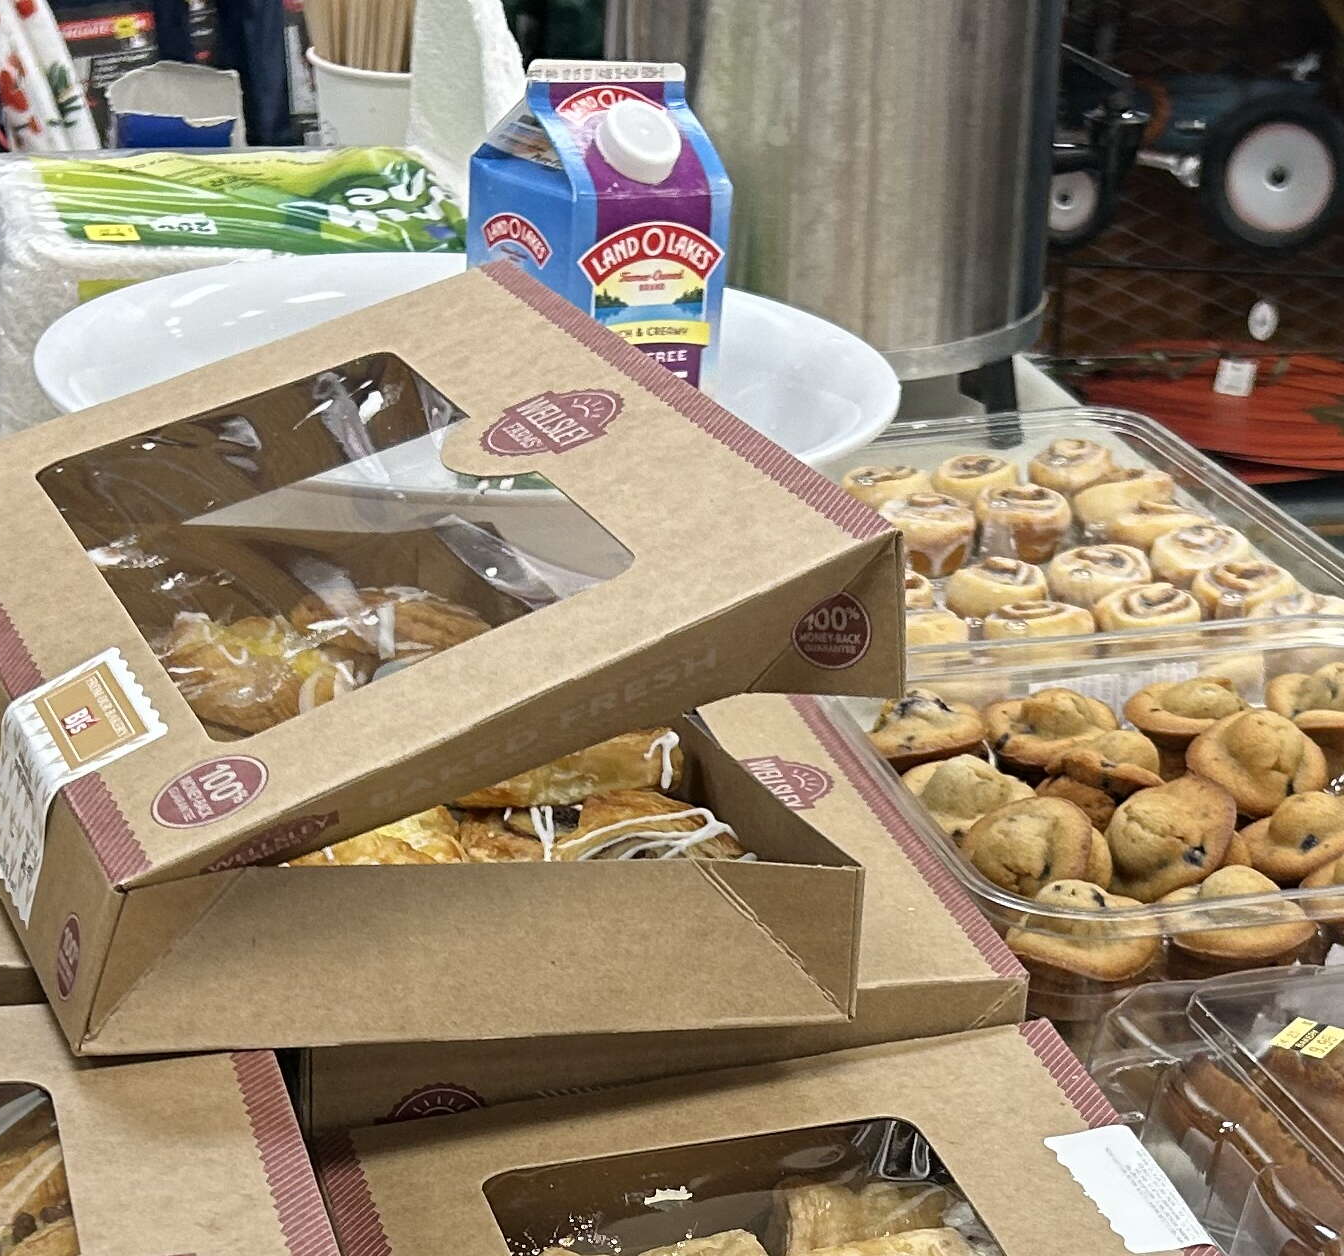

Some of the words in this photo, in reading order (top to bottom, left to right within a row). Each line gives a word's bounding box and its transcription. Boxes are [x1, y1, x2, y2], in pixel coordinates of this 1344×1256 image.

[592, 237, 640, 276] LAND
[642, 228, 666, 257] O
[666, 232, 715, 272] LAKES
[516, 396, 595, 447] WELLSLEY
[805, 605, 859, 631] 100%
